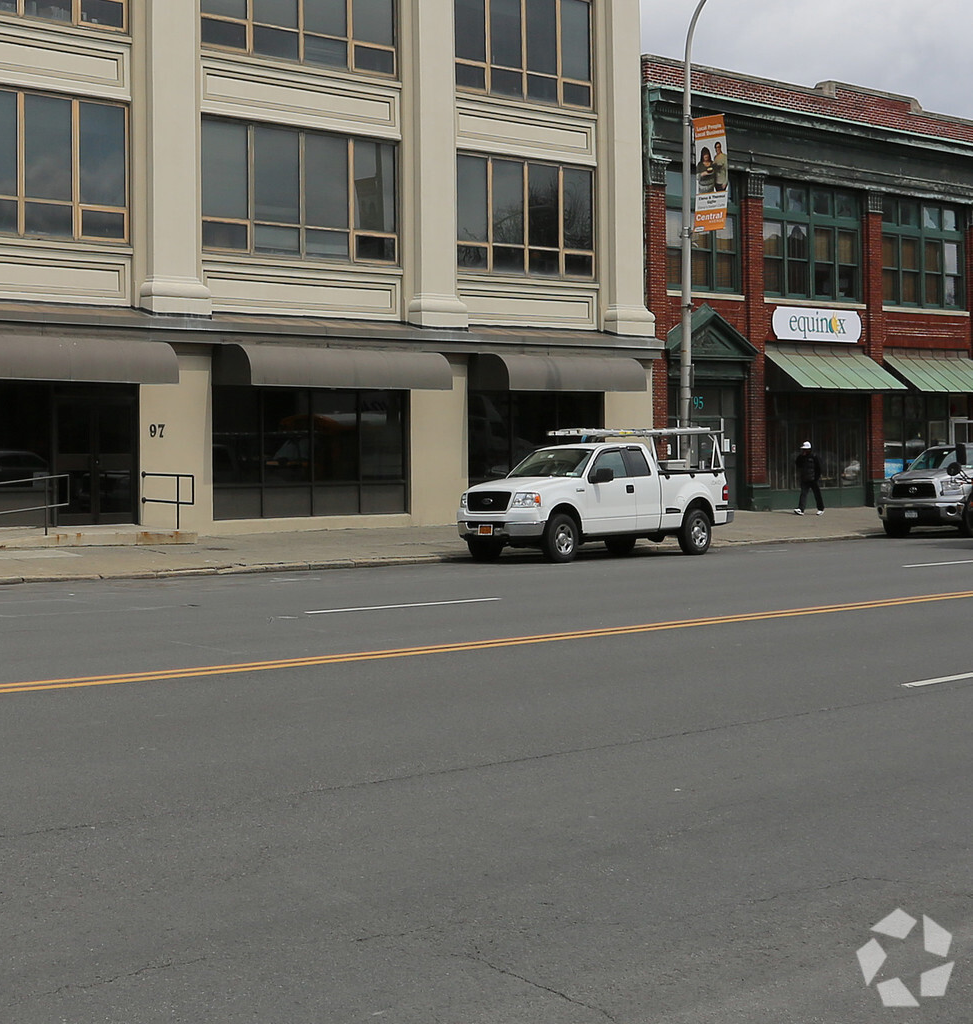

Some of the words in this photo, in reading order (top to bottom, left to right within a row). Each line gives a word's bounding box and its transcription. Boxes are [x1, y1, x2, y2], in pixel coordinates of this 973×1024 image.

[696, 212, 723, 222] Central
[789, 311, 846, 339] equinox
[693, 396, 704, 410] 95
[149, 423, 166, 438] 97
